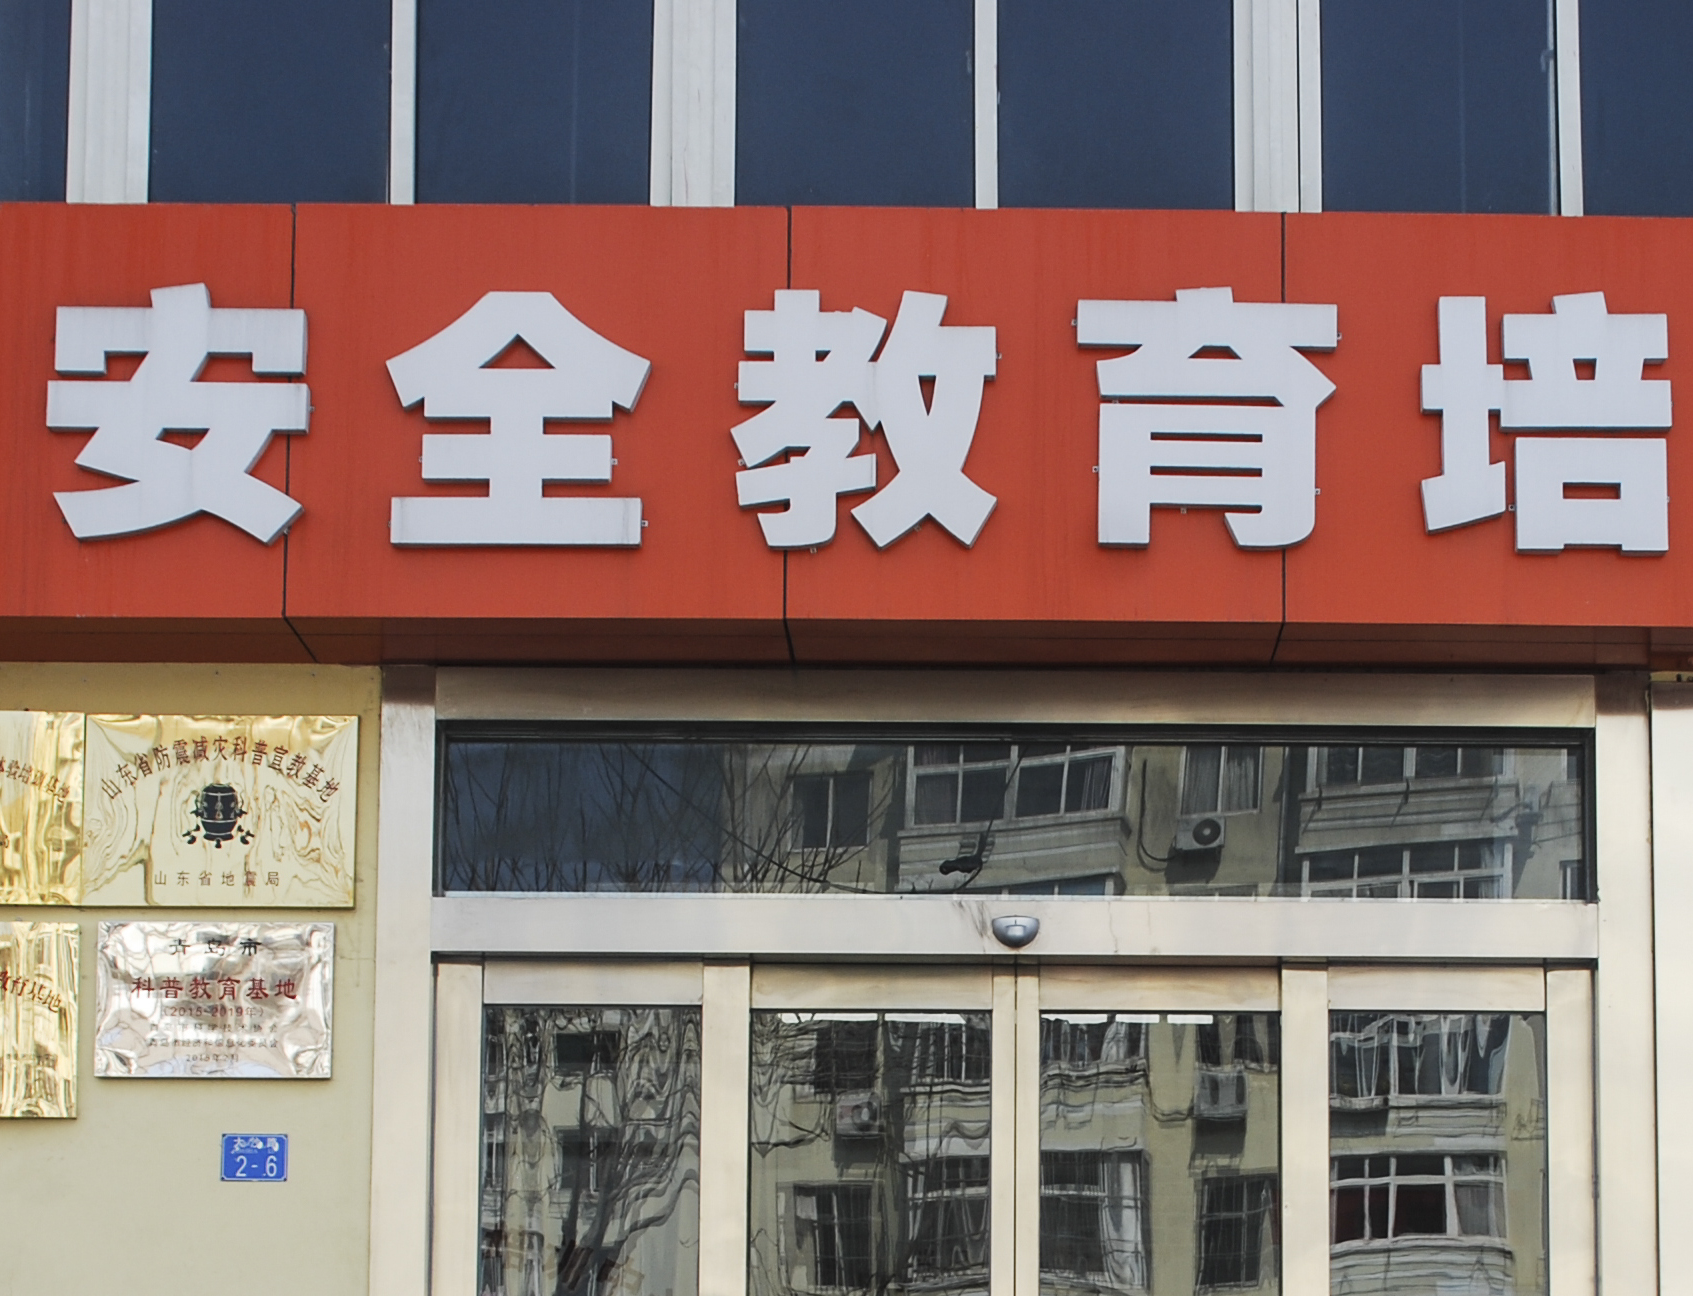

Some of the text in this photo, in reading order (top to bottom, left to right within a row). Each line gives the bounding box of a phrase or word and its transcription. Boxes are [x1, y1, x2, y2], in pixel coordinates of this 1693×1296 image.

[101, 735, 341, 803] 山东省防震减灾科普宣教基地
[154, 870, 280, 888] 山东省地震局
[168, 938, 262, 957] 青岛市
[130, 976, 298, 1000] 科普教育基地
[235, 1155, 278, 1177] 2-6
